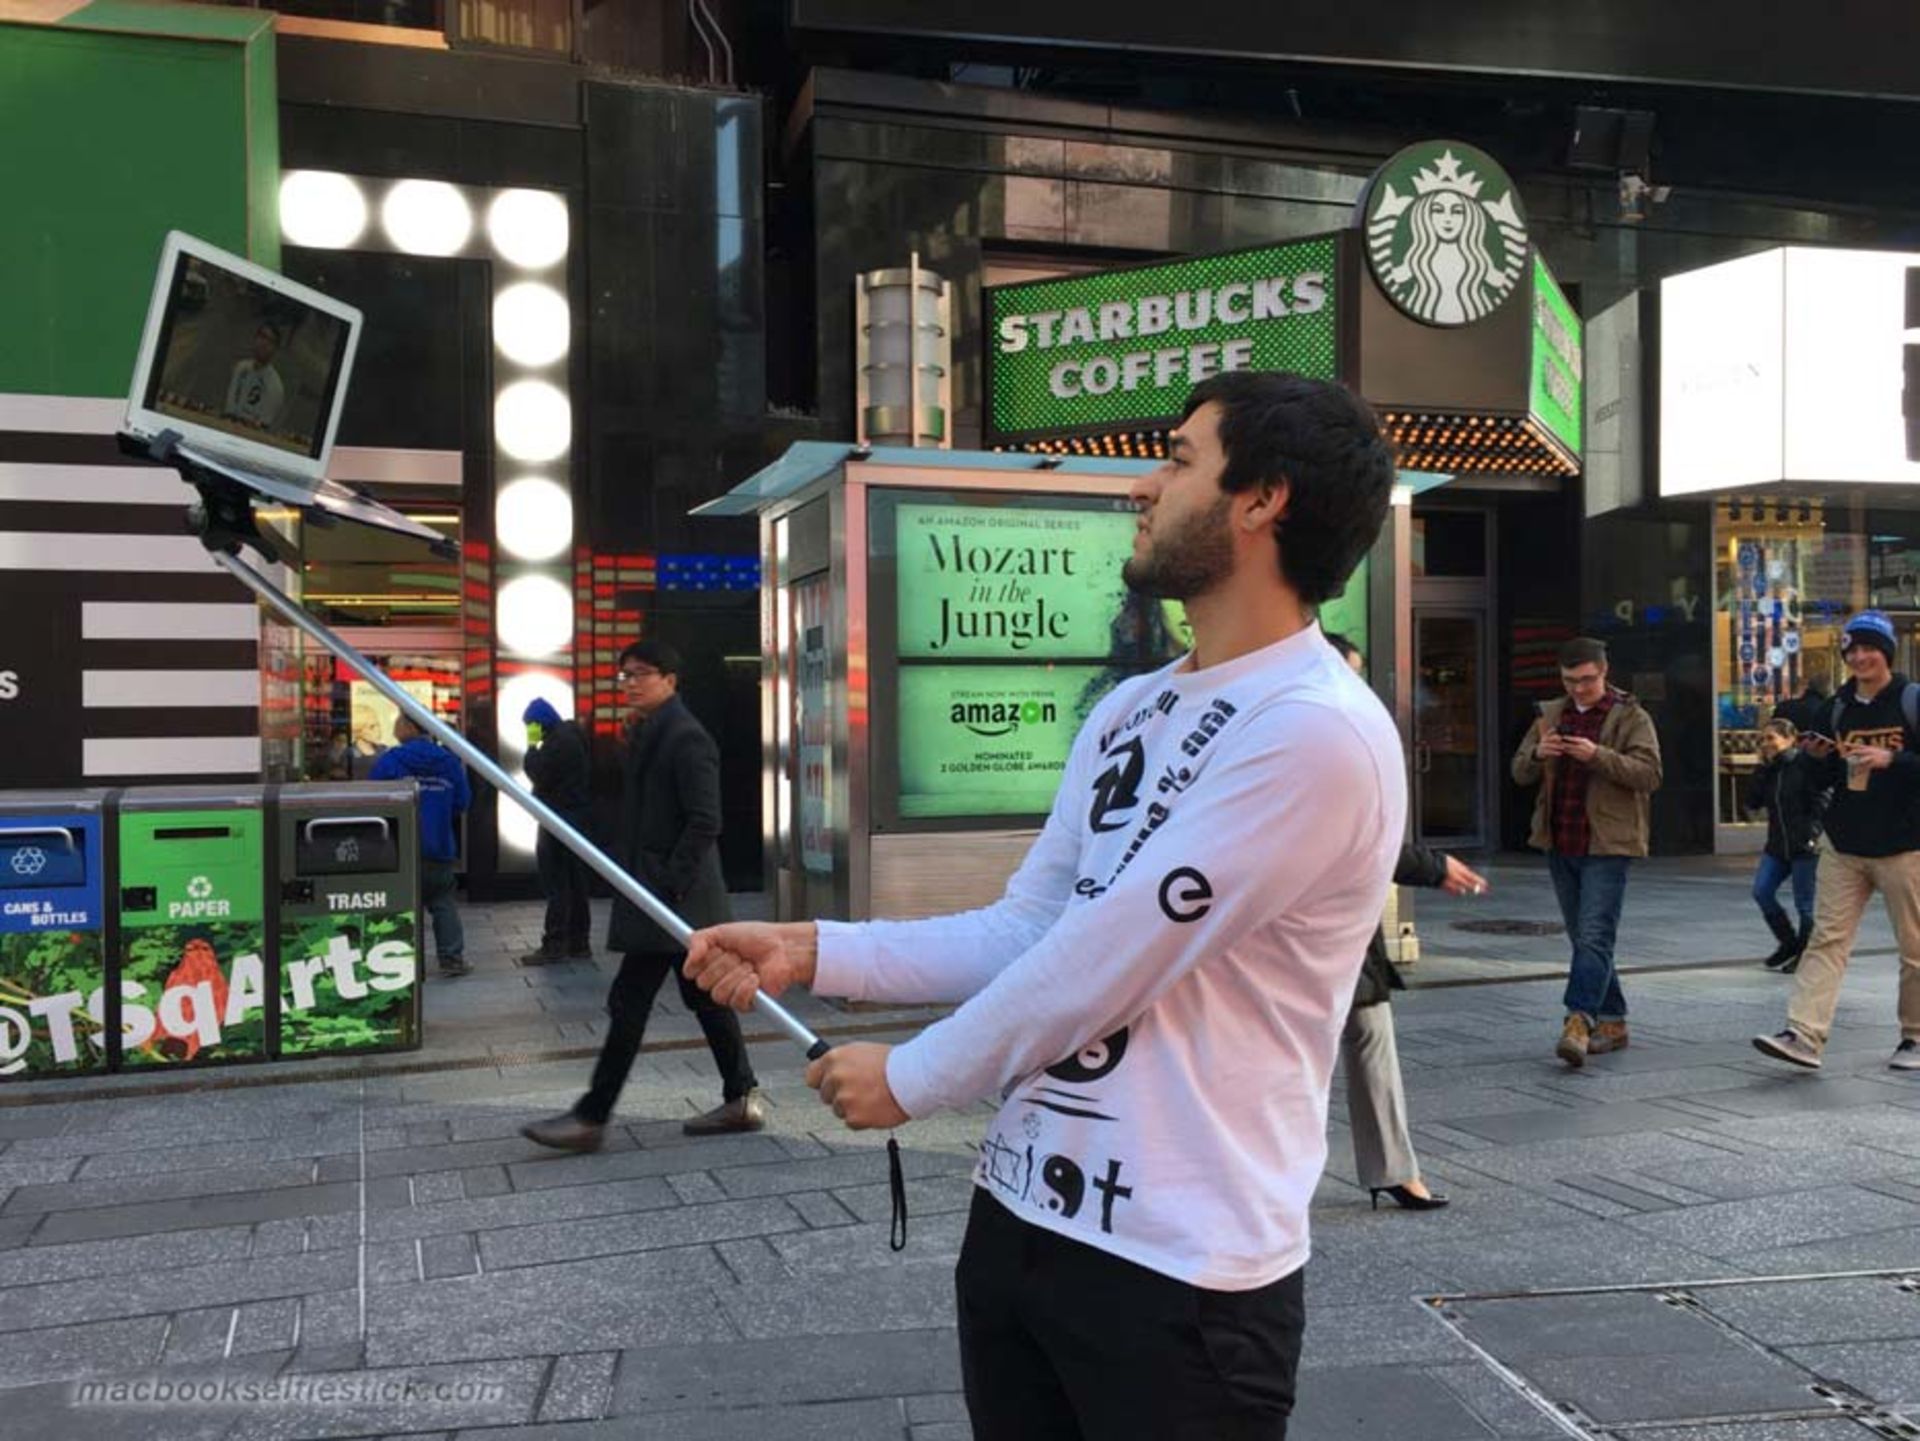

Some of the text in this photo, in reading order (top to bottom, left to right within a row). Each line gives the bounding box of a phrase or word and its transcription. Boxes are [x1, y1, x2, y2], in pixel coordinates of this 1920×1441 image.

[1000, 271, 1326, 353] STARBUCKS
[1049, 338, 1253, 399] COFFEE
[937, 517, 985, 528] AMAZON
[988, 518, 1040, 529] ORIGINAL
[1044, 520, 1080, 530] SERIES
[924, 533, 1076, 576] Mozart
[970, 578, 1031, 603] in the
[931, 598, 1069, 650] Jungle
[951, 701, 1056, 725] amazon
[974, 751, 1034, 761] NOMINATED
[948, 762, 991, 773] GOLDEN
[992, 762, 1025, 772] GLOBE
[4, 902, 53, 915] CANS &
[168, 900, 230, 919] PAPER
[327, 892, 386, 911] TRASH
[31, 911, 87, 925] BOTTLES
